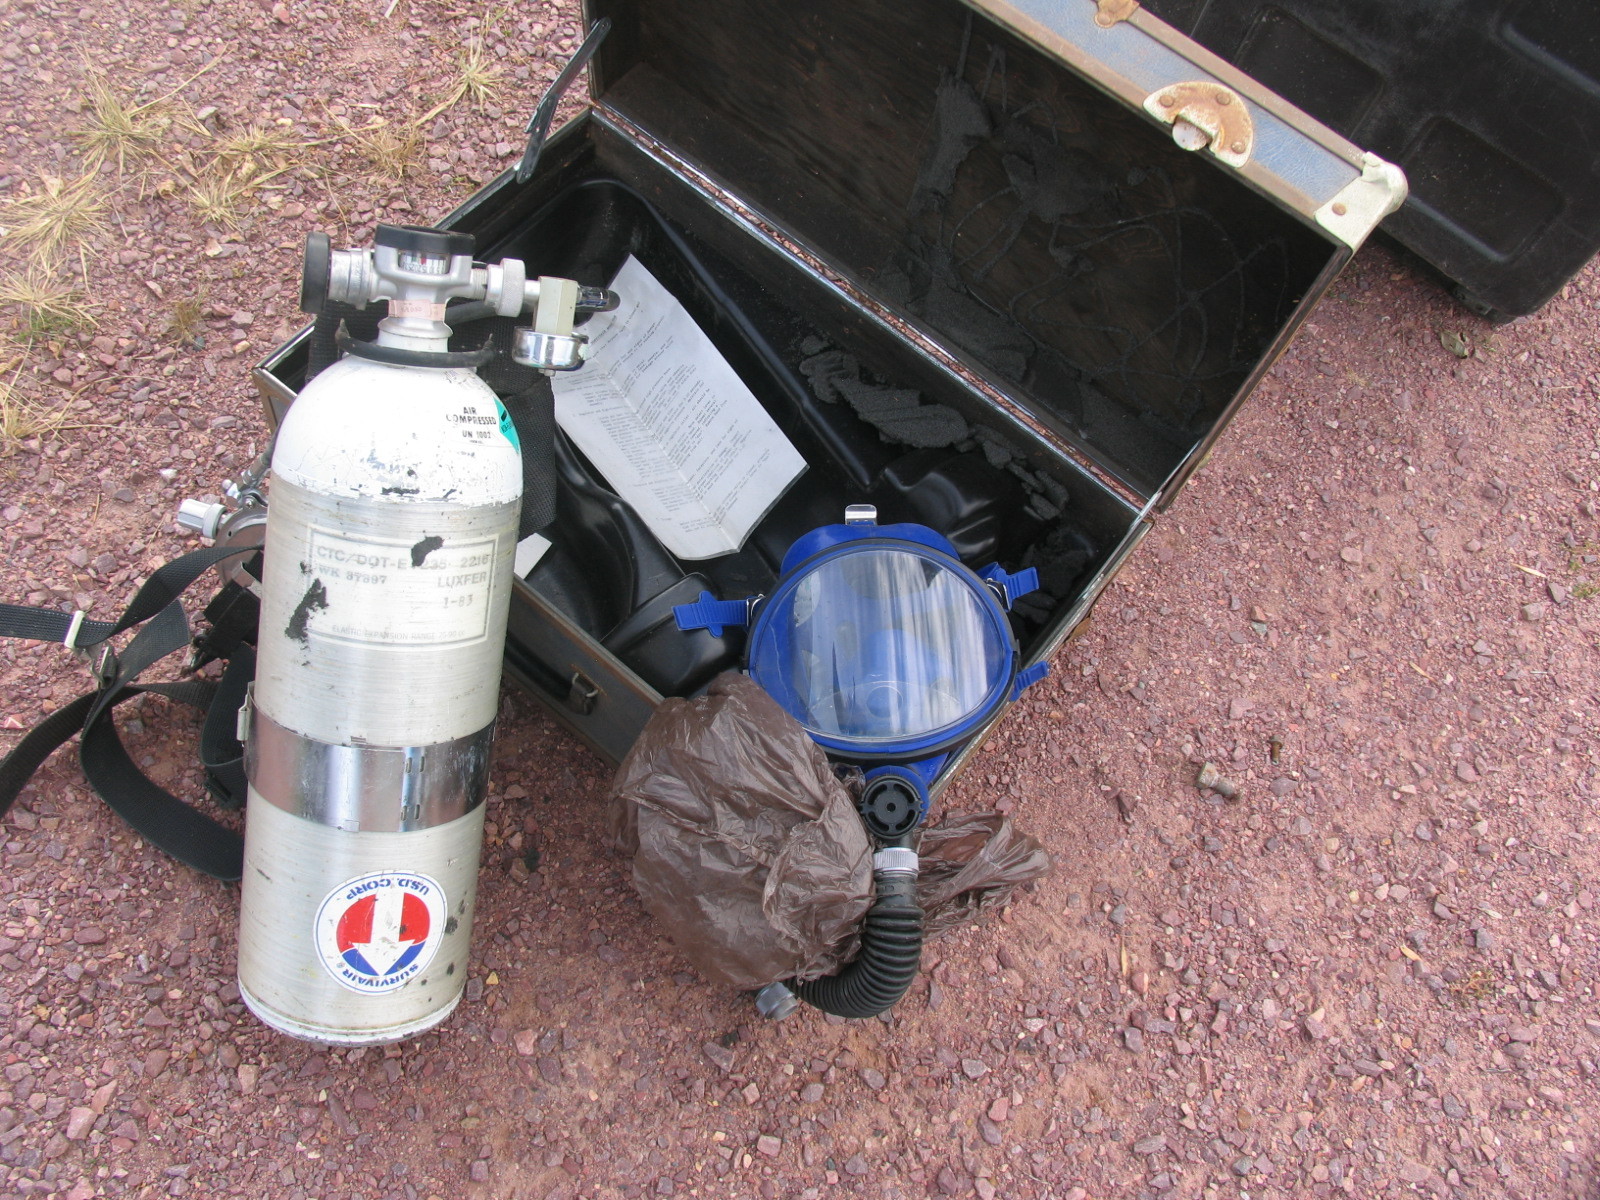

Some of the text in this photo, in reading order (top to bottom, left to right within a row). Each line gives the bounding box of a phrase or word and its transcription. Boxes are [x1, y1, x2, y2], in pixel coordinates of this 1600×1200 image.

[463, 406, 477, 415] AIR
[462, 430, 473, 438] UN
[437, 571, 488, 589] LUXFER
[341, 963, 419, 988] SURVIVAIR
